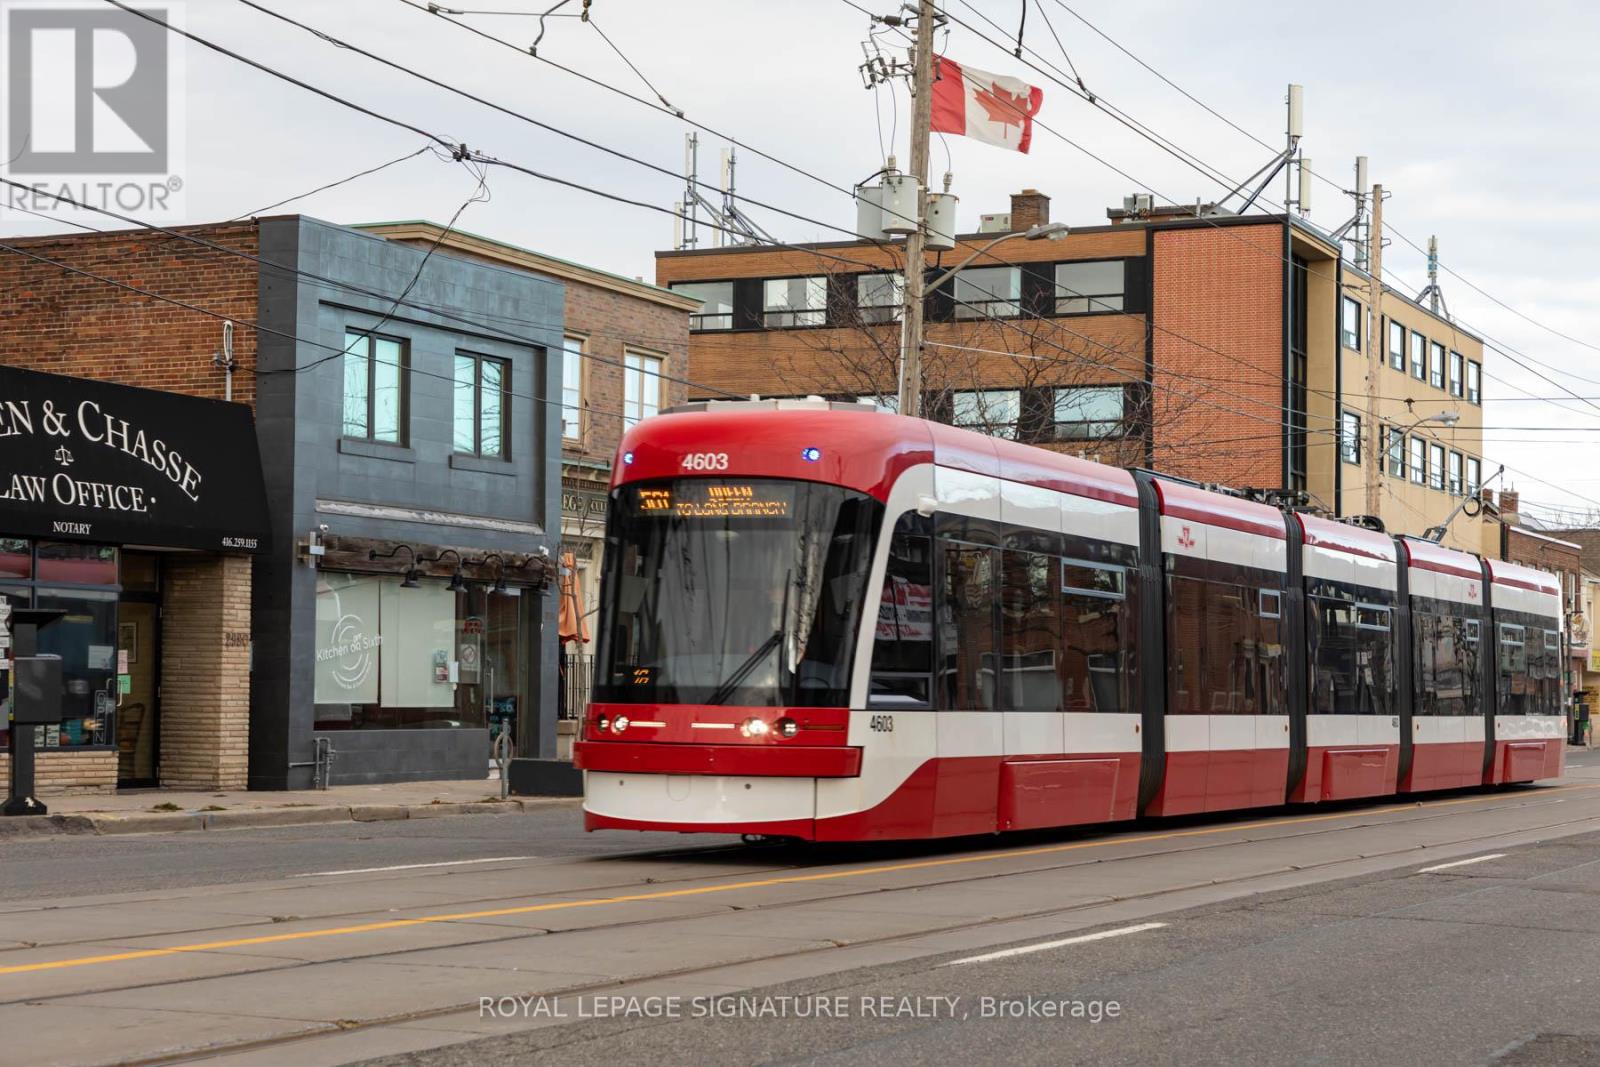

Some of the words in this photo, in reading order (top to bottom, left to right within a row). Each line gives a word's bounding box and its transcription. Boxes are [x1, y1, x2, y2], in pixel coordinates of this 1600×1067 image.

[43, 400, 70, 437] &
[77, 400, 202, 501] CHASSE
[682, 453, 729, 471] 4603
[53, 521, 92, 535] NOTARY
[316, 645, 349, 661] Kitchen
[95, 692, 106, 744] OPEN
[869, 715, 893, 732] 4603
